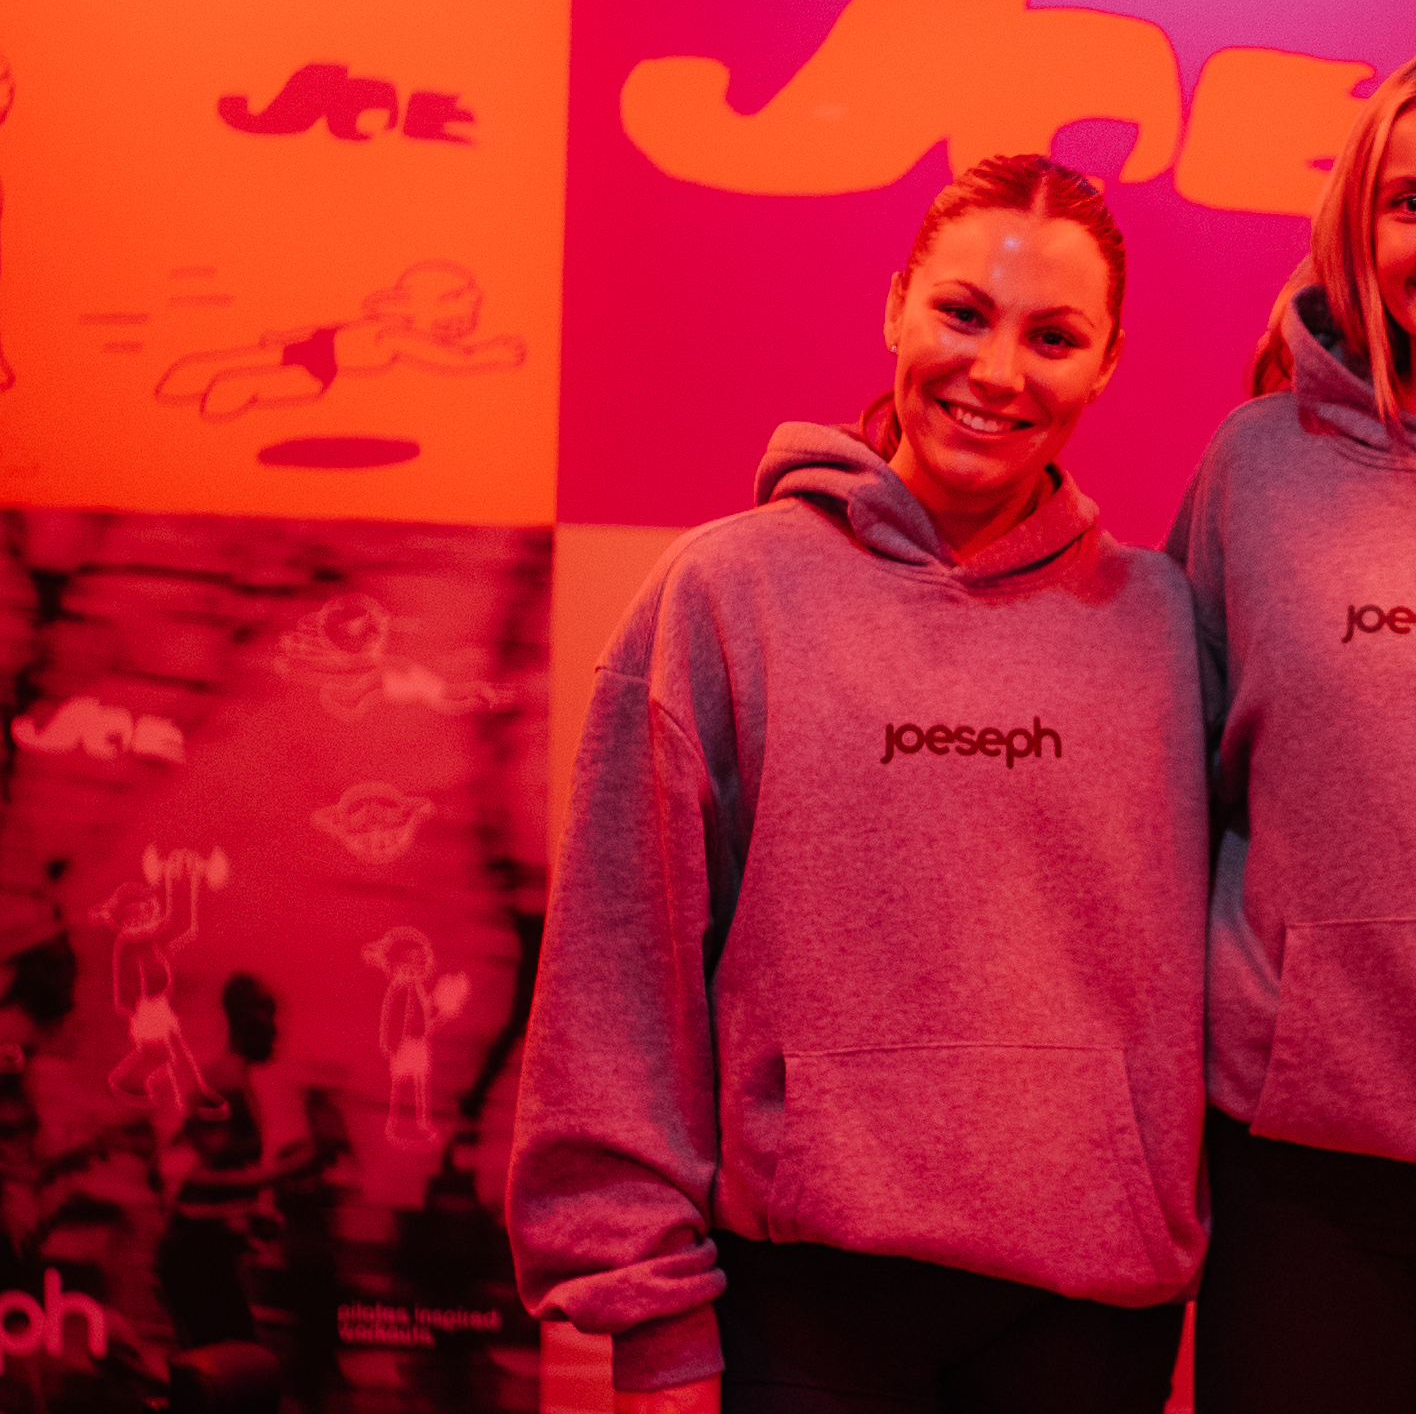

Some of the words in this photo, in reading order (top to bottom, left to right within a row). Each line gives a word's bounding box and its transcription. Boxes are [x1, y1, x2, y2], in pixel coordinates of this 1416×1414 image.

[880, 716, 1063, 770] joeseph
[414, 1302, 503, 1334] inspired
[337, 1324, 437, 1350] workouts
